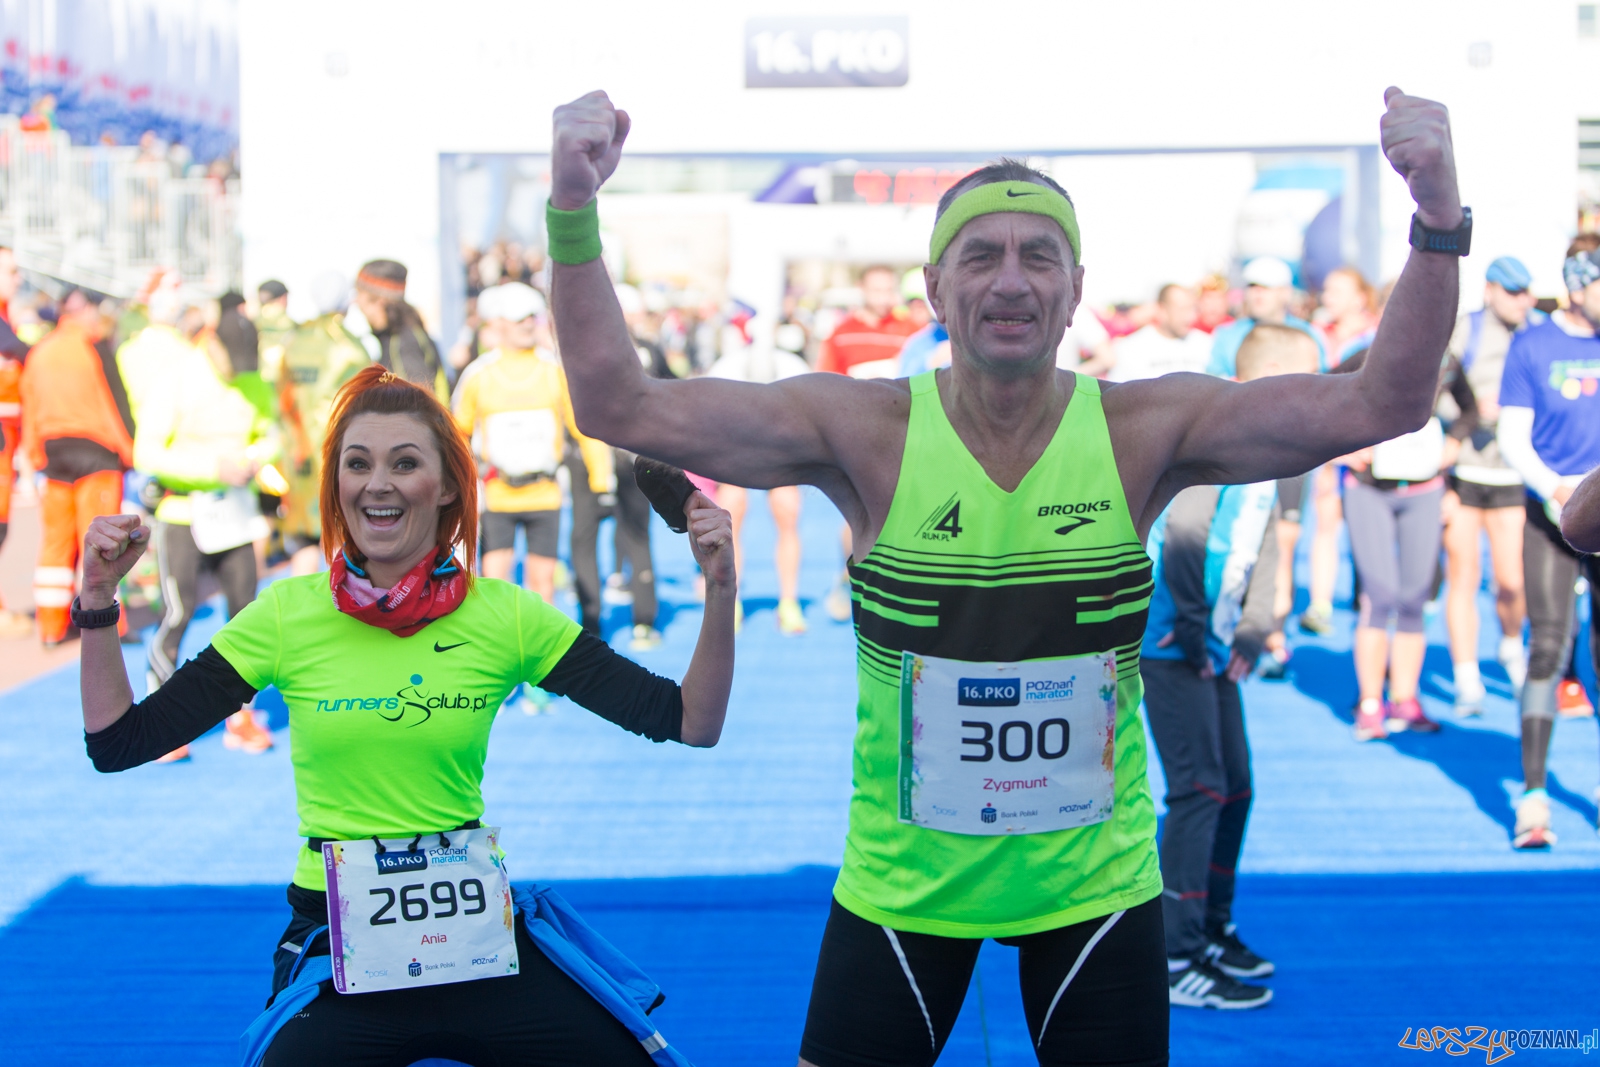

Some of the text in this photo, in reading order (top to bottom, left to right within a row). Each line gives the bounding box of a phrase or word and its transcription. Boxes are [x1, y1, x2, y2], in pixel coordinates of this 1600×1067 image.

[811, 29, 903, 74] PKO
[1037, 500, 1111, 517] BROOKS
[933, 499, 963, 538] 4
[921, 531, 949, 542] RUN.PL
[387, 585, 411, 609] WORLD
[984, 686, 1016, 699] PKO
[1025, 689, 1073, 700] maraton
[316, 693, 488, 713] runners club.pl
[960, 718, 1070, 763] 300
[983, 776, 1048, 793] Zygmunt
[1019, 810, 1038, 818] Polski
[398, 855, 423, 865] PKO
[431, 854, 468, 864] maraton
[369, 878, 487, 926] 2699
[420, 932, 447, 945] Ania
[425, 961, 456, 971] Bank Polski
